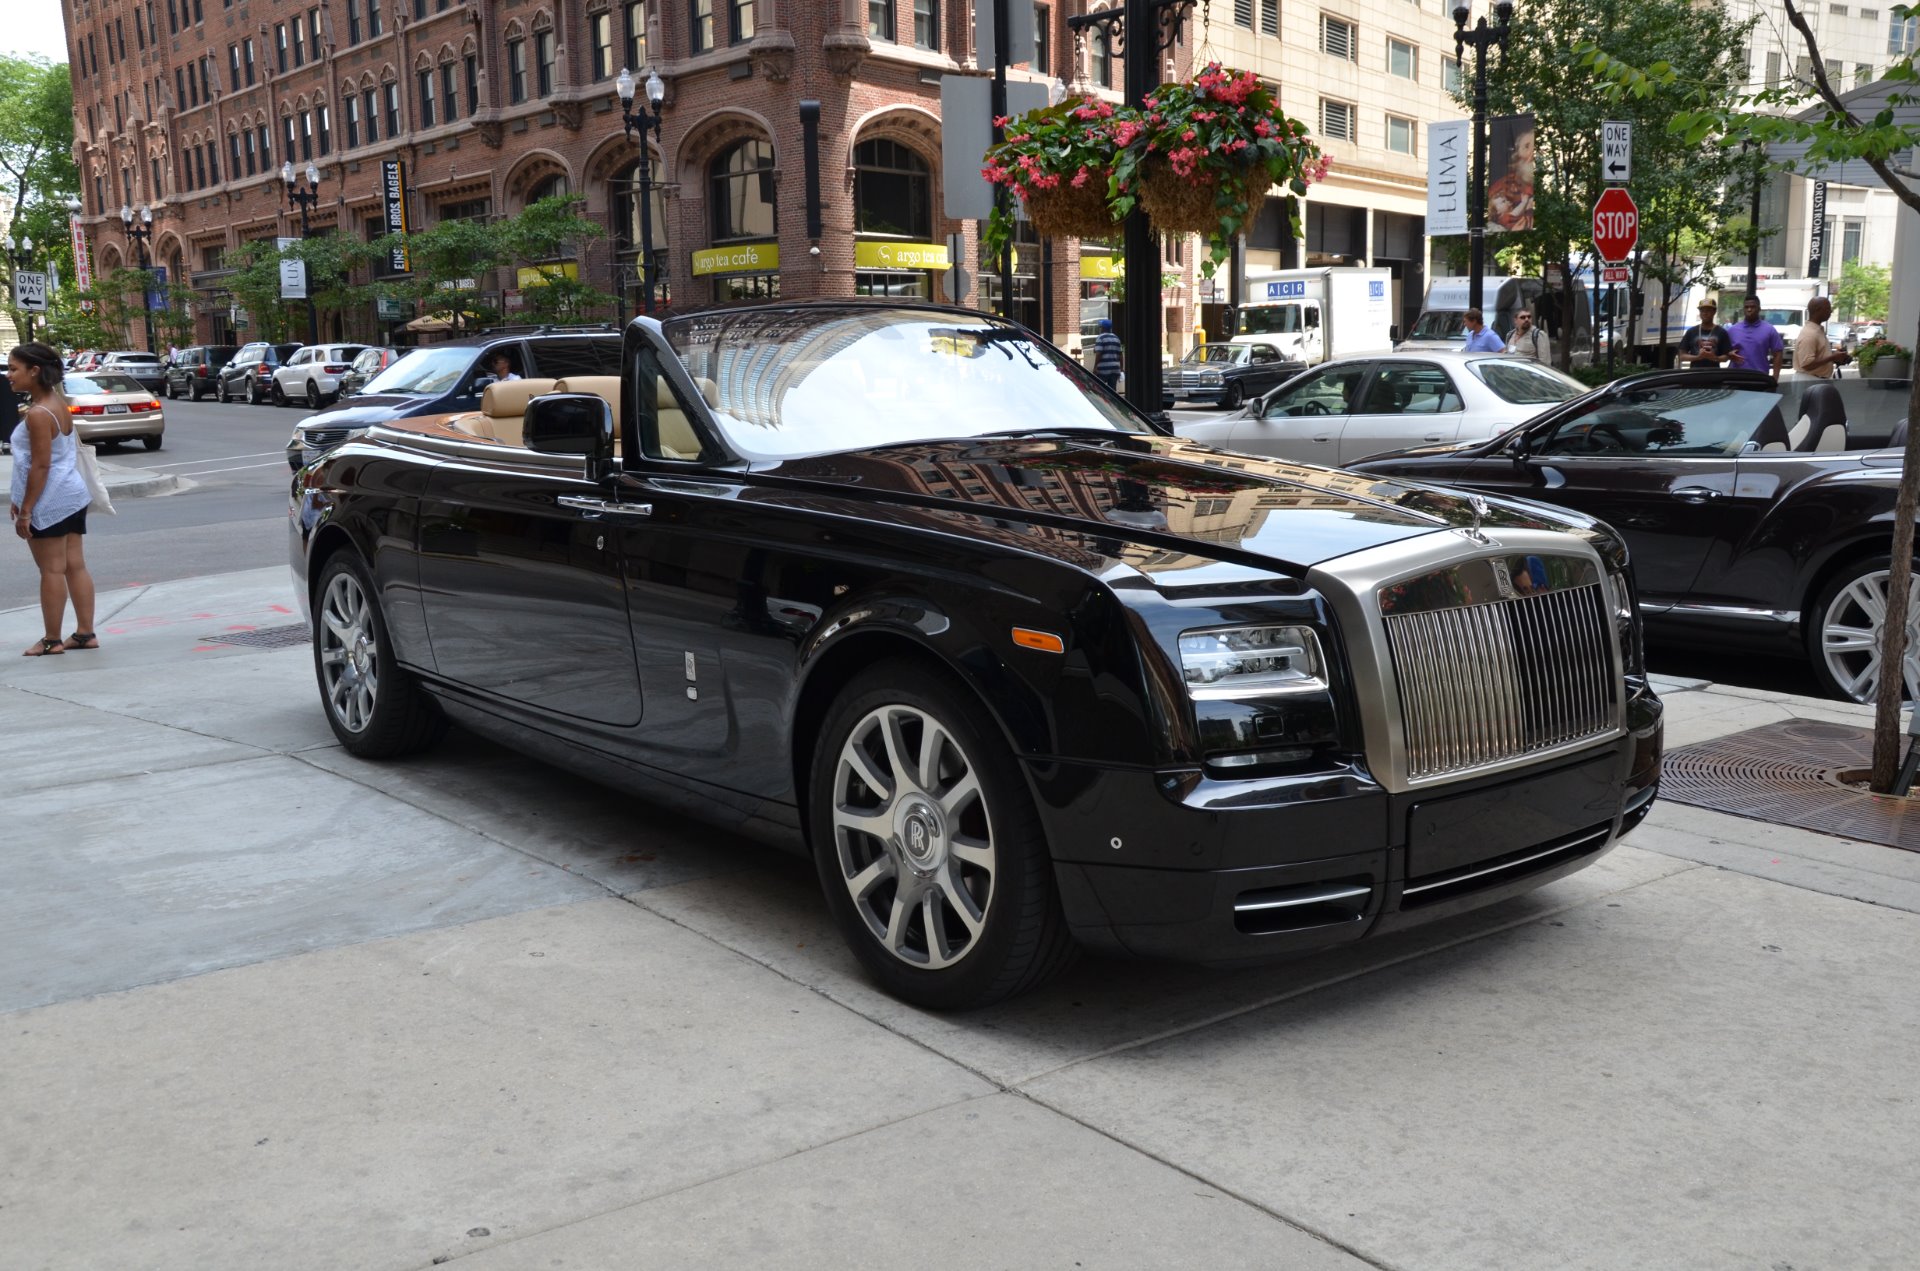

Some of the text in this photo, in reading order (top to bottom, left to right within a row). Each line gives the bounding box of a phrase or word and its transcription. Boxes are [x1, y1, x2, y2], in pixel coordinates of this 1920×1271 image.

[1606, 127, 1628, 141] ONE
[1606, 144, 1628, 158] WAY
[386, 163, 400, 199] BAGELS
[1438, 135, 1458, 213] LUMA
[1596, 211, 1636, 240] STOP
[1810, 180, 1824, 261] ORDSTROM rack
[392, 231, 406, 270] EINSN
[700, 246, 759, 271] argo tea café
[897, 250, 920, 266] argo
[922, 250, 934, 263] tea
[18, 274, 42, 286] ONE
[1605, 270, 1626, 280] ALL WAY
[18, 285, 43, 296] WAY
